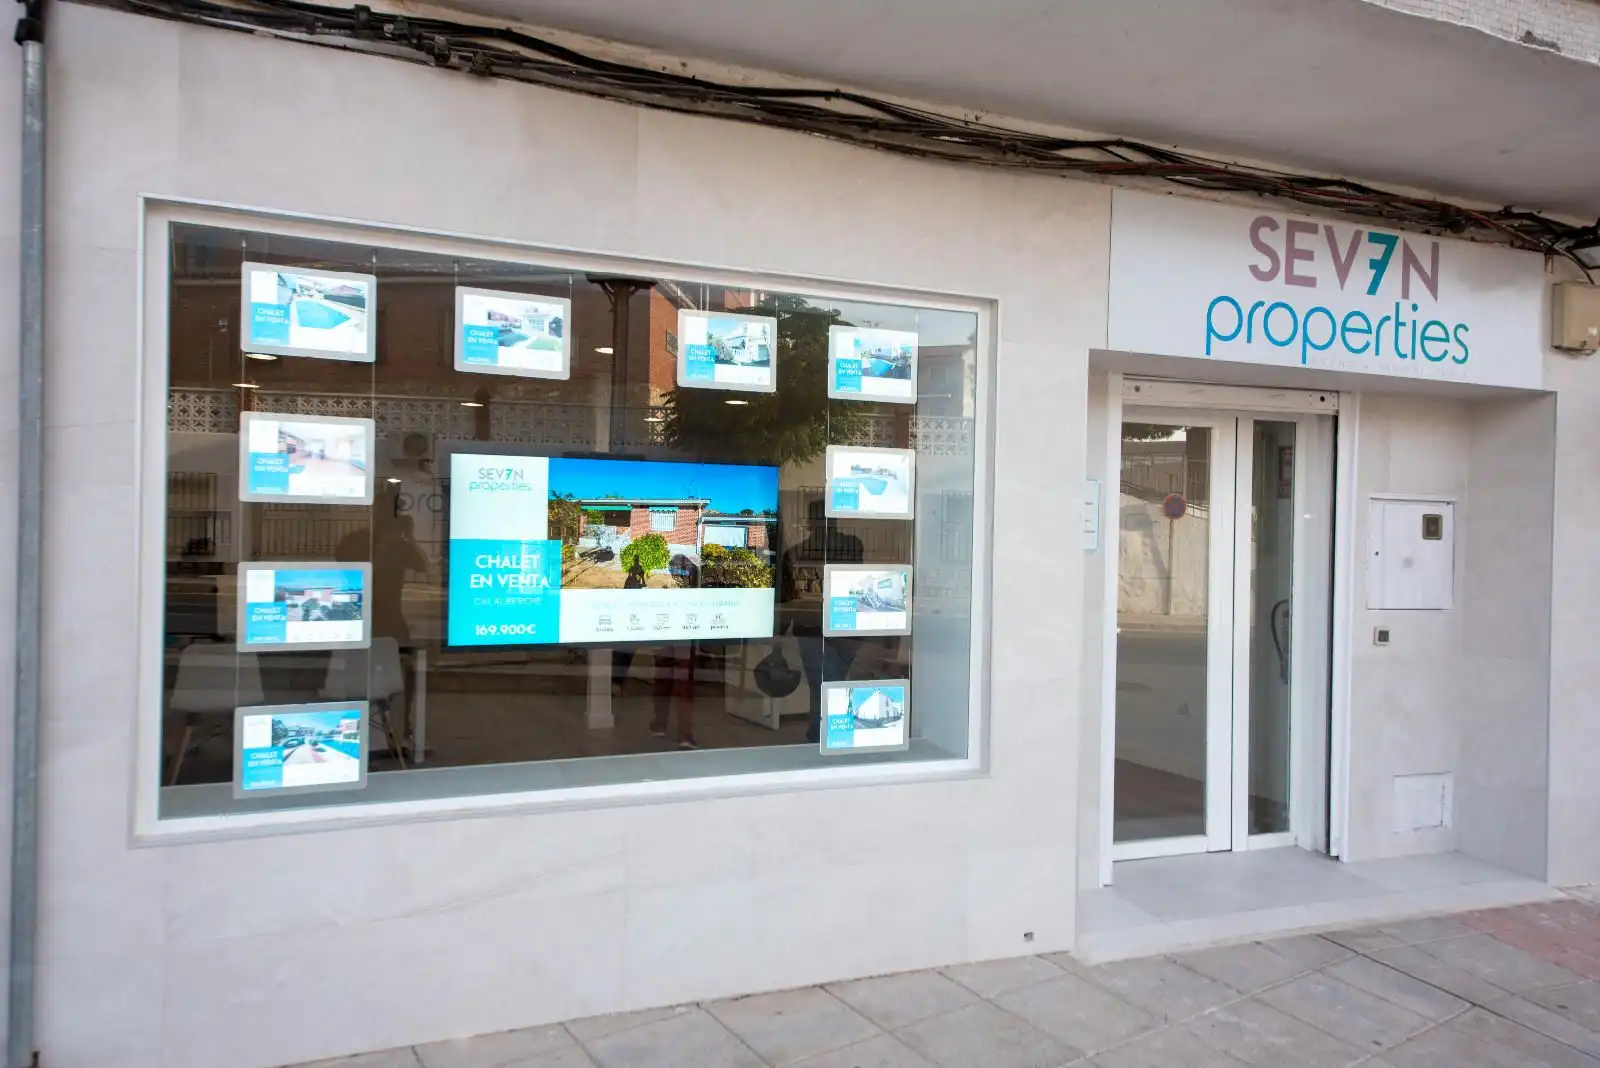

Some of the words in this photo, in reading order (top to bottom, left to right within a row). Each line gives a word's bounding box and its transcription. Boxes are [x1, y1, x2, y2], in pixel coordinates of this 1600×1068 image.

[1248, 214, 1440, 302] SEV7N
[1206, 295, 1469, 365] properties
[478, 468, 524, 480] SEV7N
[469, 481, 533, 492] properties
[475, 554, 541, 569] CHALET
[469, 573, 493, 588] EN
[497, 573, 550, 588] VENTA
[475, 624, 537, 636] 169.900€
